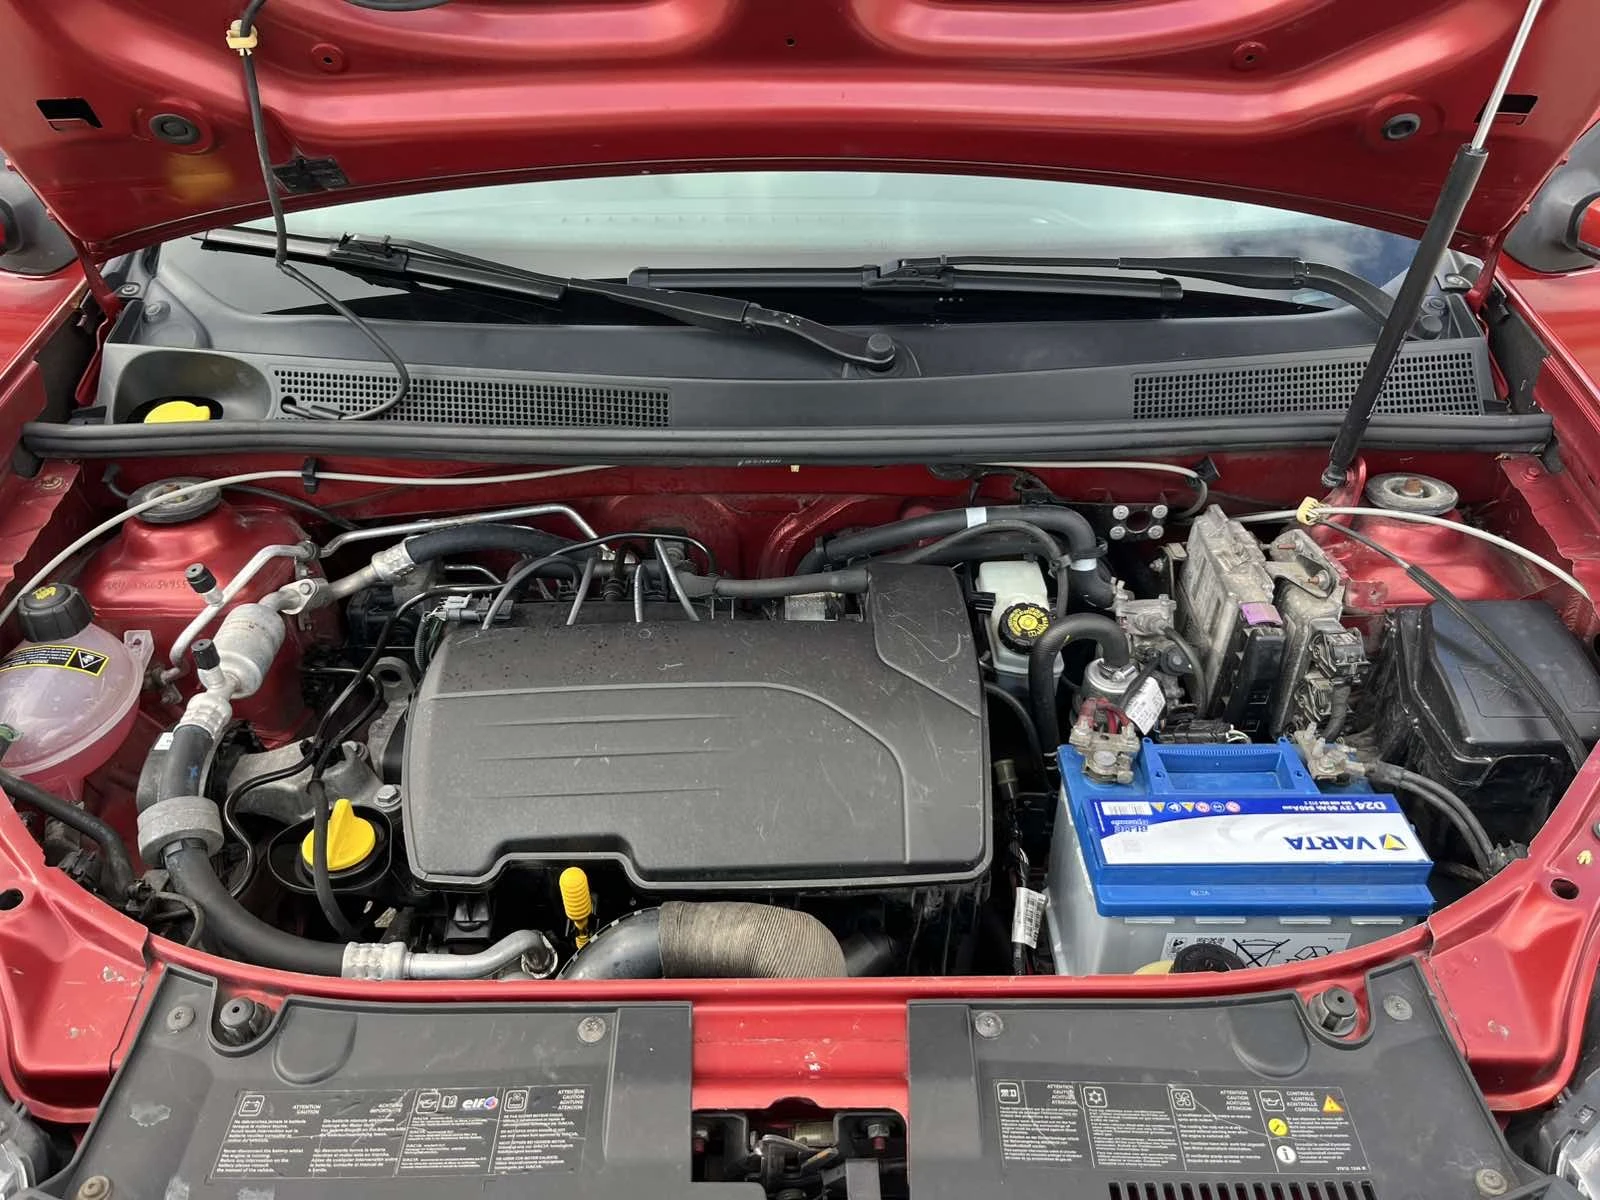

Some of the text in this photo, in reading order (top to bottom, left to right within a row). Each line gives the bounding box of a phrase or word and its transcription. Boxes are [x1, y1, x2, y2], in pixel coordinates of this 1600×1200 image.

[1355, 800, 1387, 810] D24
[1282, 836, 1377, 850] VARTA
[462, 1096, 485, 1110] elf
